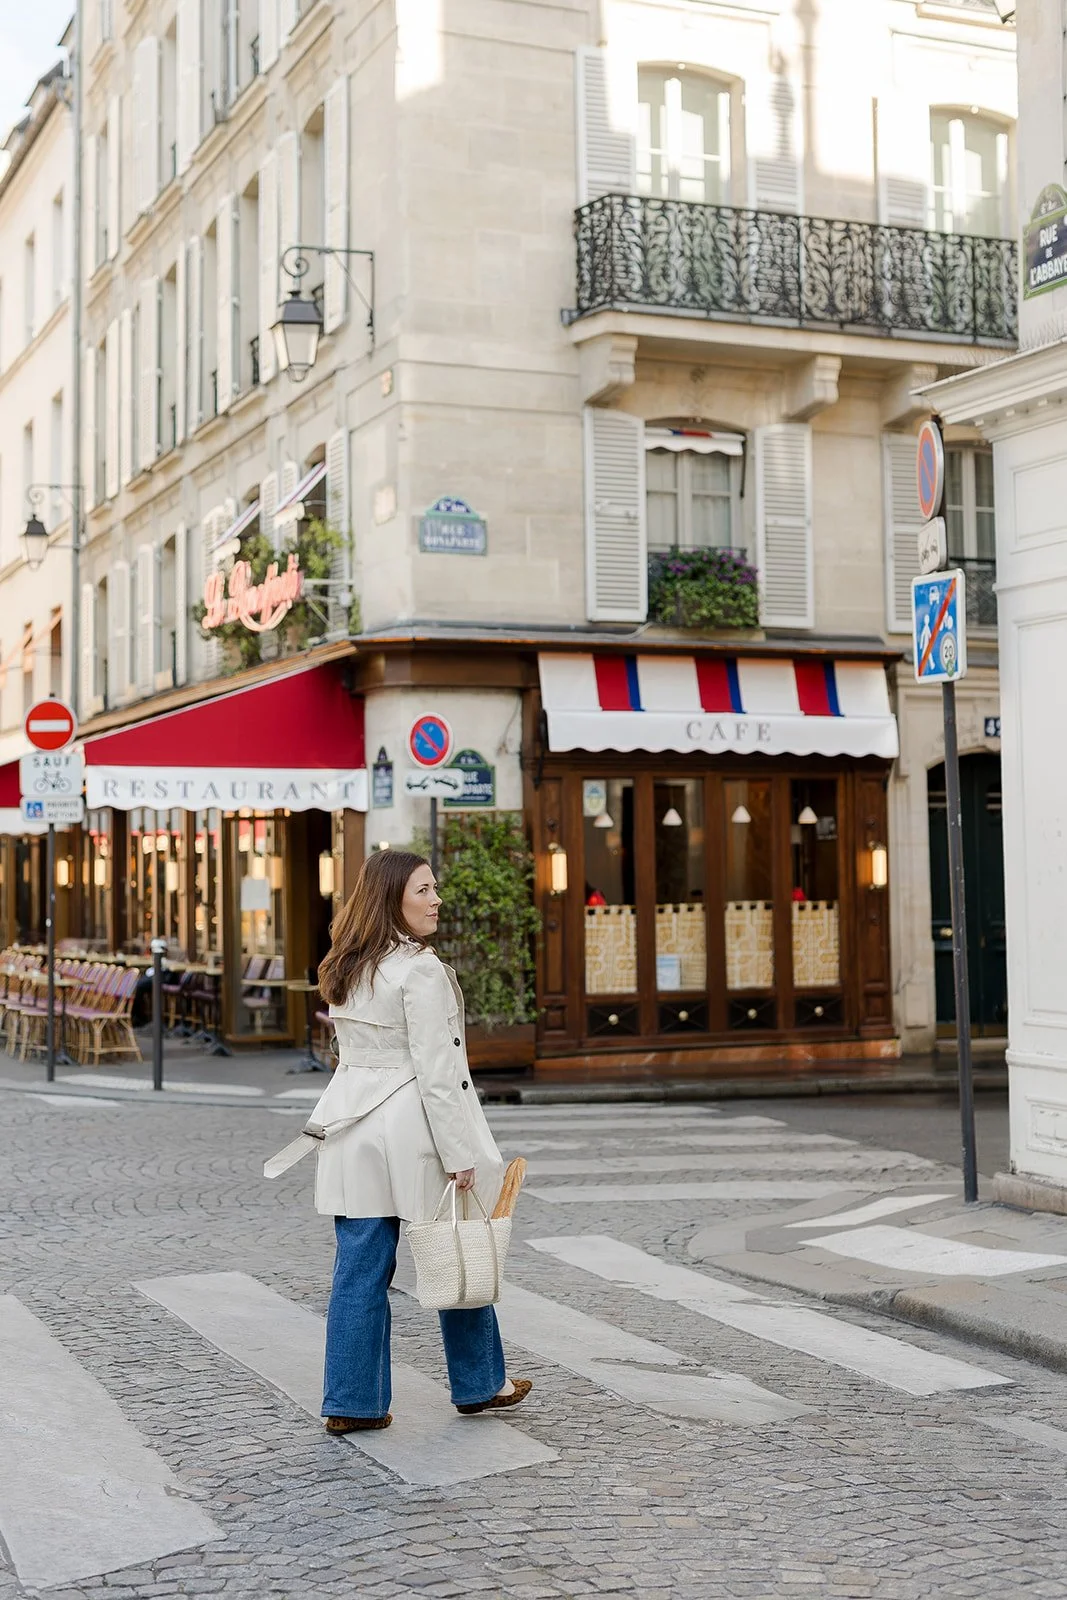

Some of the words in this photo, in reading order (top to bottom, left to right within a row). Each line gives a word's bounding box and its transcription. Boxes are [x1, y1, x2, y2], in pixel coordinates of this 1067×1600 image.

[1039, 223, 1059, 248] RUE
[1045, 246, 1053, 259] DE
[686, 720, 772, 742] CAFE
[33, 756, 72, 769] SAUF
[103, 778, 355, 801] RESTAURANT
